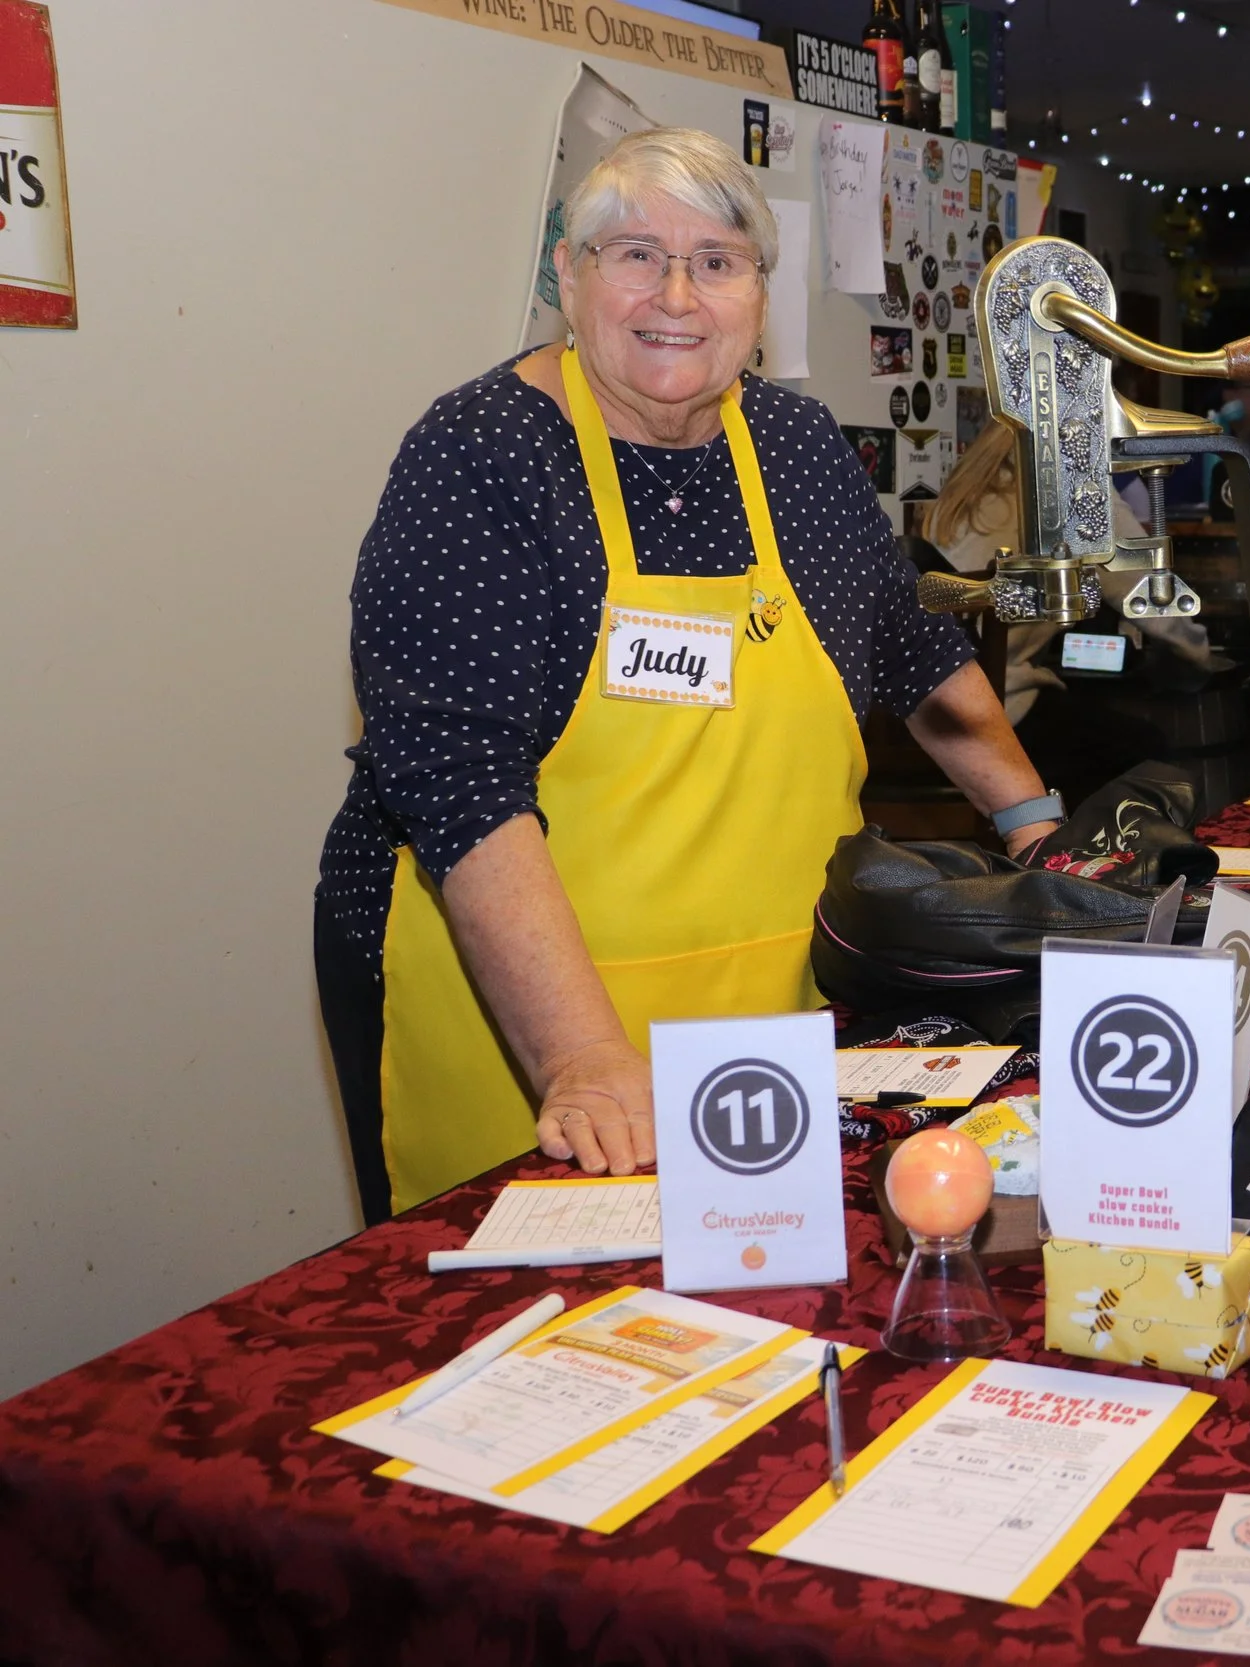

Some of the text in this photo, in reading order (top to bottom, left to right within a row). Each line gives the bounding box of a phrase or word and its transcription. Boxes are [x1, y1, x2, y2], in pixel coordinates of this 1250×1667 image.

[536, 0, 577, 34] THE
[585, 5, 665, 62] OLDER
[662, 31, 698, 64] THE
[702, 36, 774, 87] BETTER
[797, 33, 876, 85] IT'S 5 O'CLOCK
[797, 67, 879, 117] SOMEWHERE
[1037, 373, 1055, 508] ESTATE
[621, 638, 709, 687] Judy
[1096, 1031, 1172, 1092] 22
[717, 1087, 776, 1146] 11
[1099, 1198, 1174, 1215] slow cooker
[1100, 1183, 1169, 1199] Super Bowl
[1088, 1212, 1180, 1231] Kitchen Bundle
[968, 1393, 1138, 1426] Cooker Kitchen
[972, 1382, 1153, 1417] Super Bowl Slow
[1006, 1409, 1082, 1427] Bundle
[1177, 1605, 1229, 1618] SUGAR
